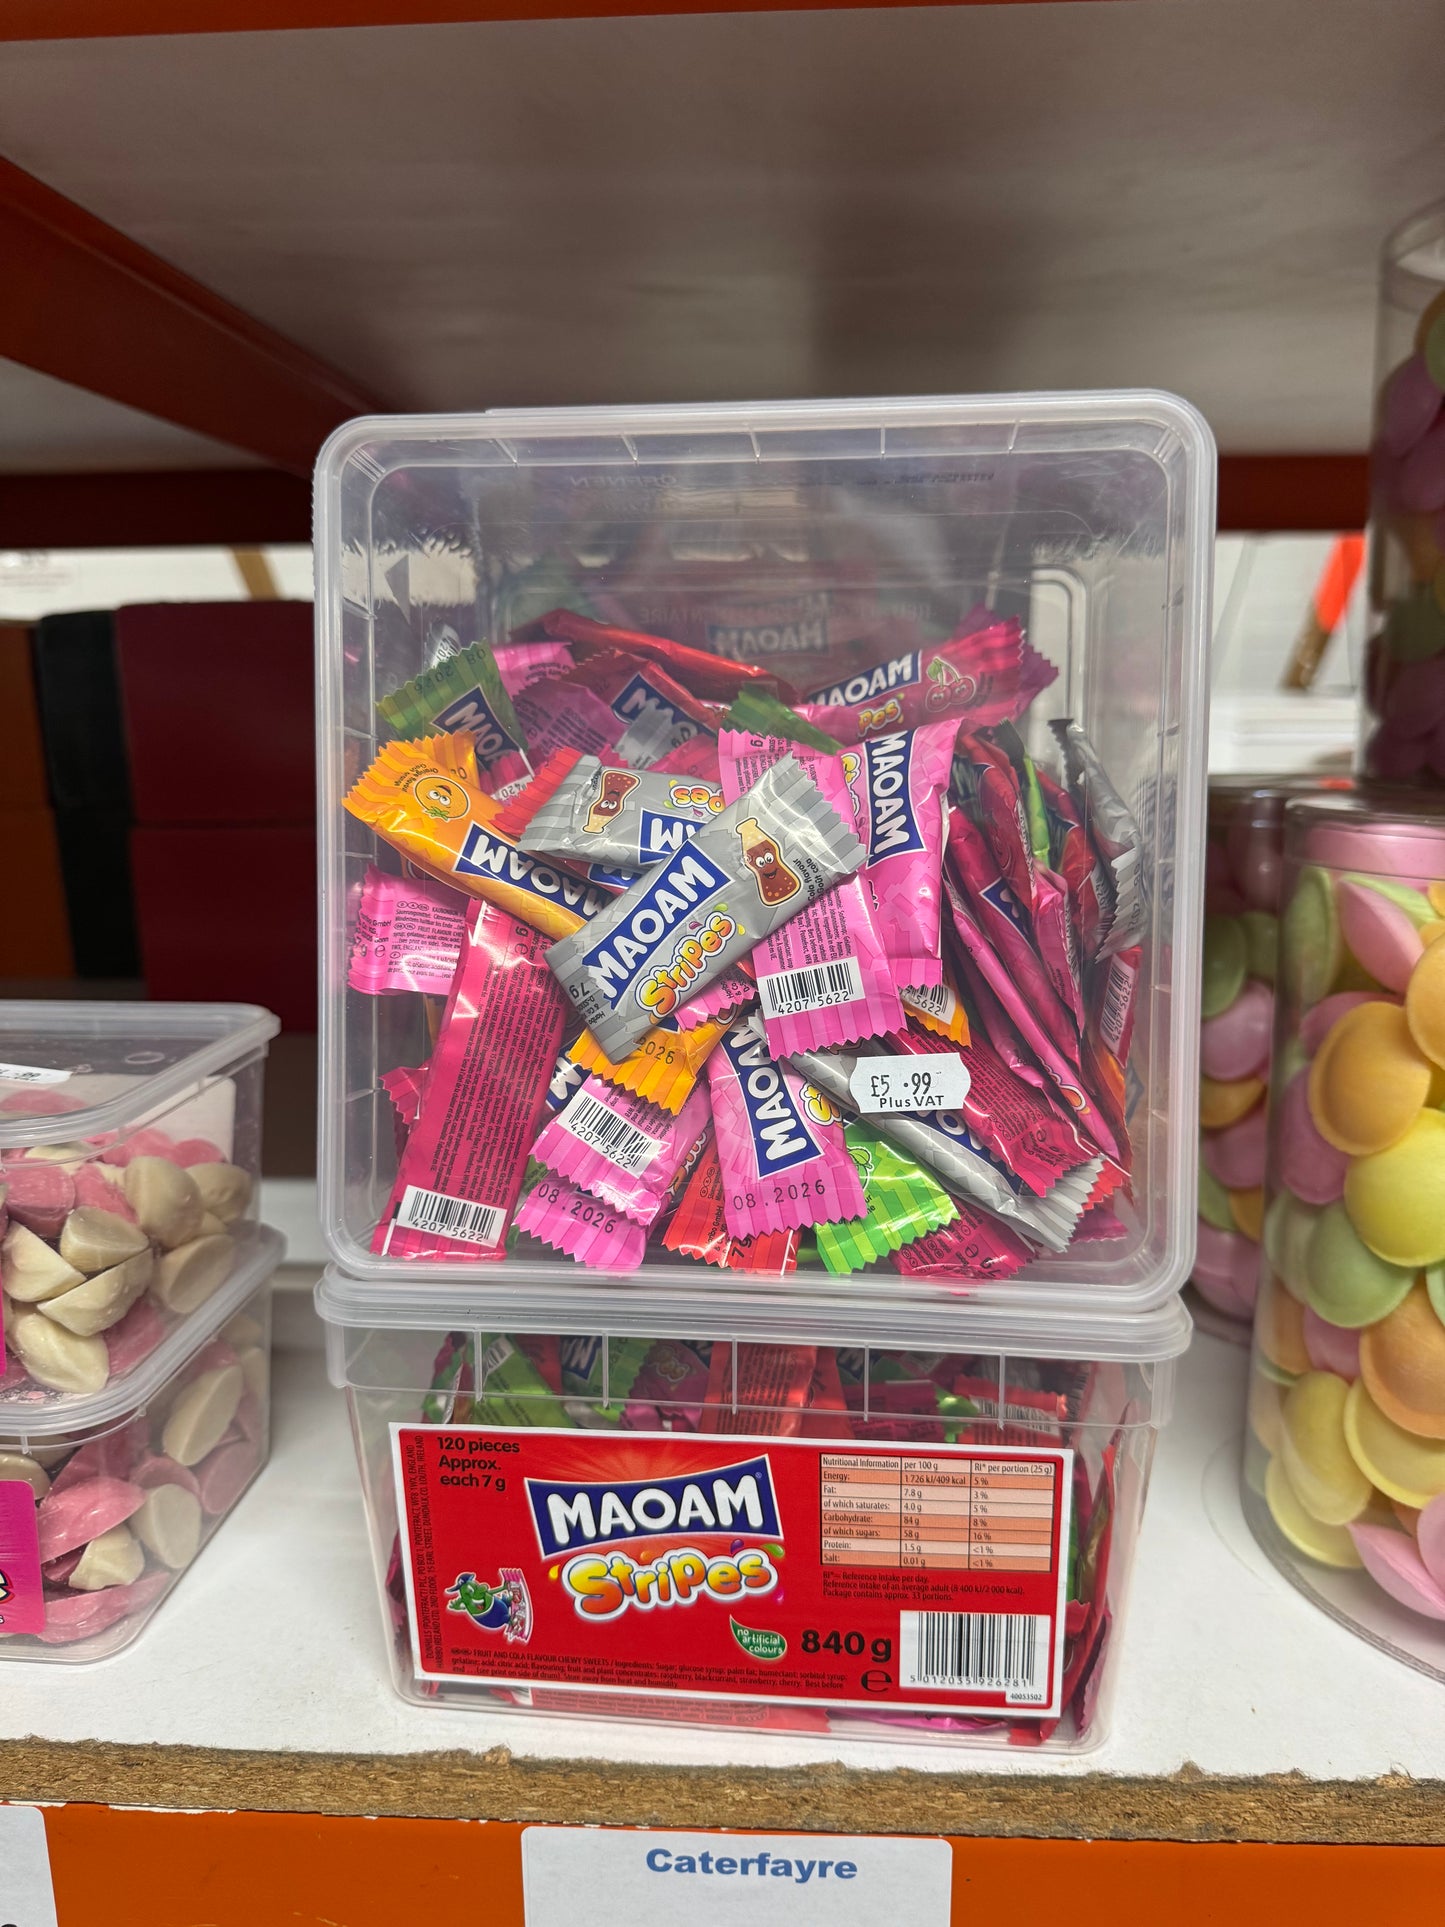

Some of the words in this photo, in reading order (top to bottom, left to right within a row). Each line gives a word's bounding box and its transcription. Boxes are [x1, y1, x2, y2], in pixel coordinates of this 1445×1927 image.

[870, 731, 909, 854] MAOAM
[591, 856, 716, 998] MAOAM
[637, 913, 735, 1016] Stripes
[778, 1000, 809, 1014] 4207
[818, 991, 850, 1006] 5622
[914, 995, 941, 1016] 5622
[730, 1023, 807, 1160] MAOAM
[880, 1097, 911, 1108] Plus
[914, 1095, 944, 1107] VAT
[570, 1123, 600, 1147] 4207
[603, 1144, 634, 1169] 5622
[412, 1217, 445, 1233] 4207
[452, 1227, 484, 1243] 5622
[437, 1437, 465, 1450] 120
[469, 1438, 520, 1454] pieces
[439, 1455, 501, 1471] Approx.
[823, 1457, 858, 1467] Nutritional
[860, 1458, 899, 1469] Information
[919, 1461, 932, 1469] 100
[988, 1465, 1000, 1473] per
[1002, 1464, 1029, 1474] portion
[1030, 1465, 1043, 1474] (25
[440, 1474, 479, 1487] each
[482, 1475, 492, 1487] 7
[495, 1478, 506, 1491] g
[823, 1471, 850, 1483] Energy:
[952, 1476, 966, 1484] kcal
[824, 1485, 837, 1494] Fat:
[546, 1475, 764, 1545] MAOAM
[833, 1500, 854, 1509] which
[856, 1502, 890, 1510] saturates:
[824, 1513, 873, 1523] Carbohydrate:
[833, 1527, 854, 1536] which
[856, 1530, 880, 1538] sugars:
[824, 1540, 851, 1549] Protein:
[904, 1543, 915, 1551] 1.5
[824, 1553, 840, 1562] Salt:
[903, 1557, 918, 1565] 0.01
[565, 1549, 776, 1619] Stripes
[901, 1575, 913, 1583] per
[930, 1583, 949, 1592] adult
[742, 1635, 780, 1645] artificial
[749, 1643, 783, 1653] colours
[801, 1629, 865, 1656] 840
[871, 1637, 892, 1663] g
[646, 1848, 858, 1883] Caterfayre
